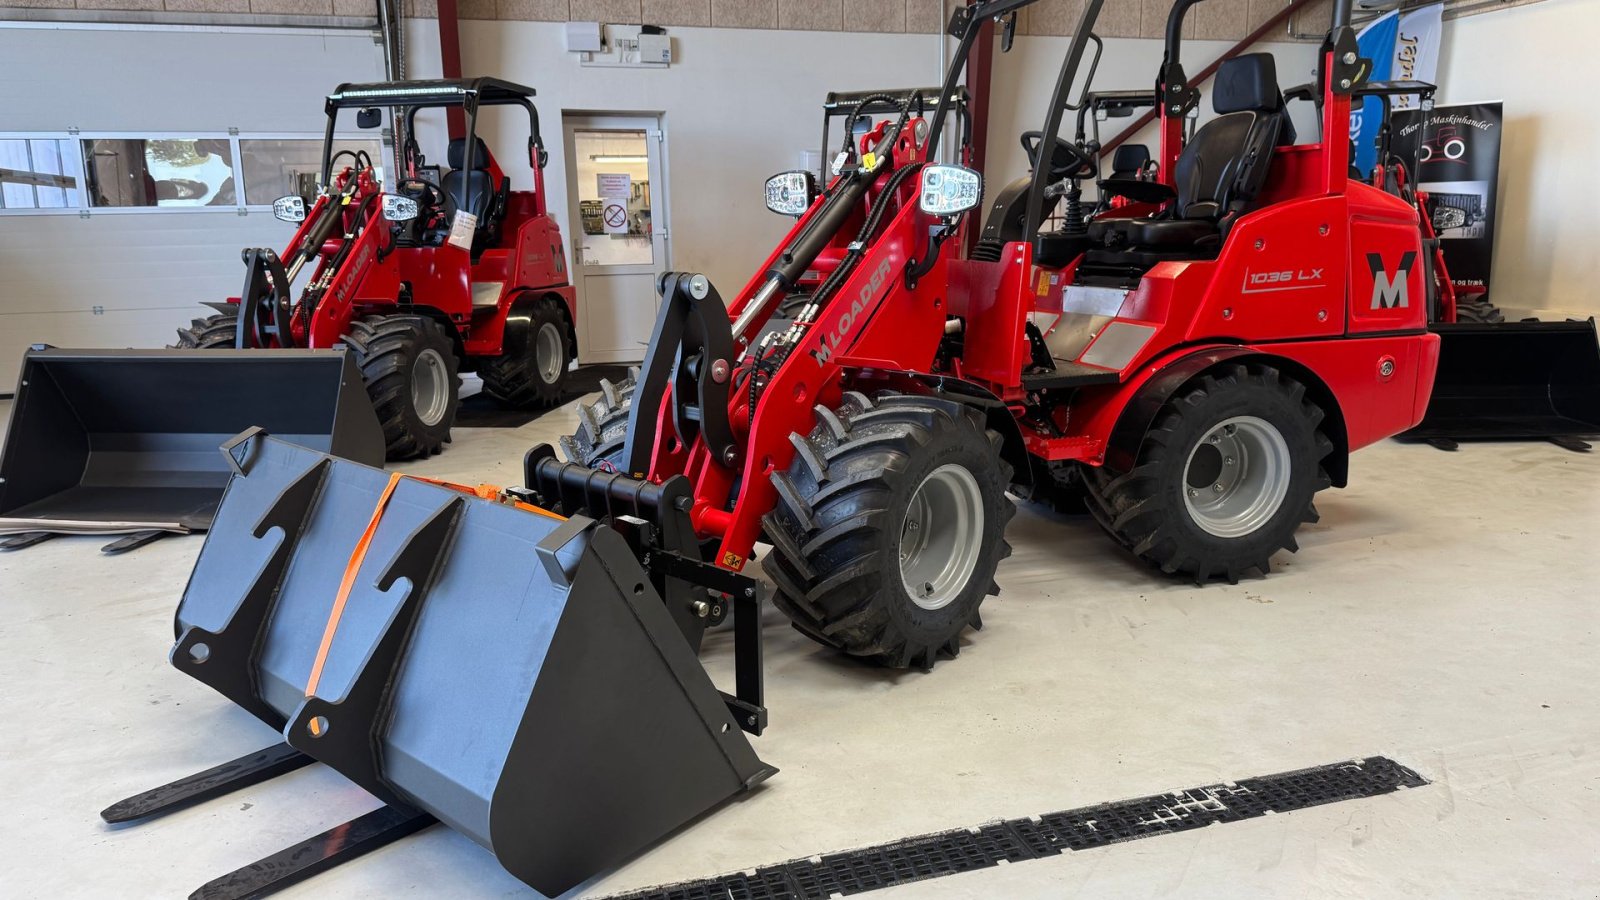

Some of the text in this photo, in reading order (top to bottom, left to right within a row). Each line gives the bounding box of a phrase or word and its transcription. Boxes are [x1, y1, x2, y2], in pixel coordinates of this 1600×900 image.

[1400, 114, 1493, 137] Thorp Maskinhandel
[1250, 268, 1324, 284] 1036 LX
